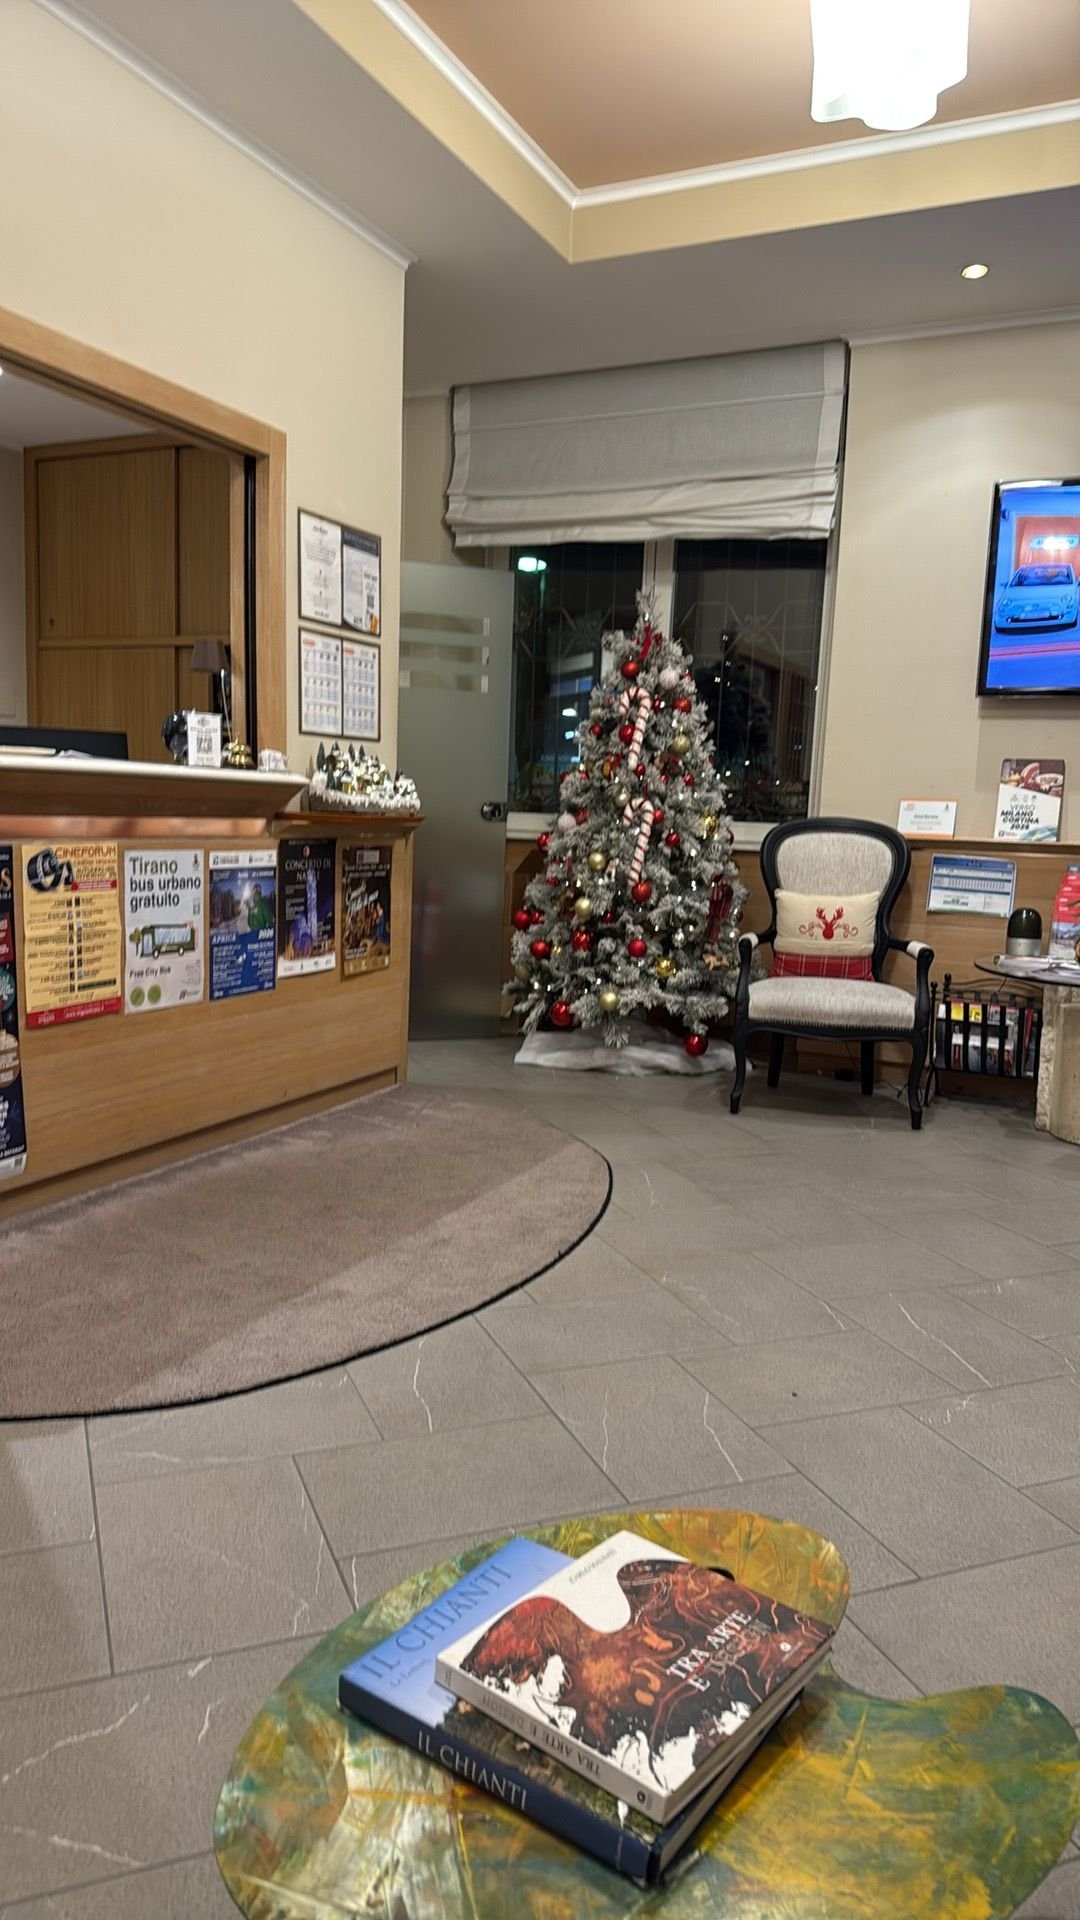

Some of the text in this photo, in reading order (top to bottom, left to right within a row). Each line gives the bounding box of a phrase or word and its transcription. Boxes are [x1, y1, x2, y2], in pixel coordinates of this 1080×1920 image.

[1000, 809, 1034, 817] MILANO
[1002, 816, 1039, 824] CORTINA
[55, 846, 116, 859] CINEFORUM
[129, 856, 178, 876] Tirano
[130, 876, 154, 893] bus
[158, 875, 201, 891] urbano
[130, 891, 180, 913] gratuito
[129, 966, 171, 979] Free City Bus
[360, 1655, 400, 1679] IL
[395, 1564, 512, 1652] CHIANTI
[665, 1609, 751, 1679] TRA ARTE
[687, 1675, 710, 1692] E
[531, 1724, 539, 1737] E
[543, 1735, 571, 1756] ARTE
[418, 1730, 527, 1811] IL CHIANTI
[576, 1755, 600, 1776] TRA
